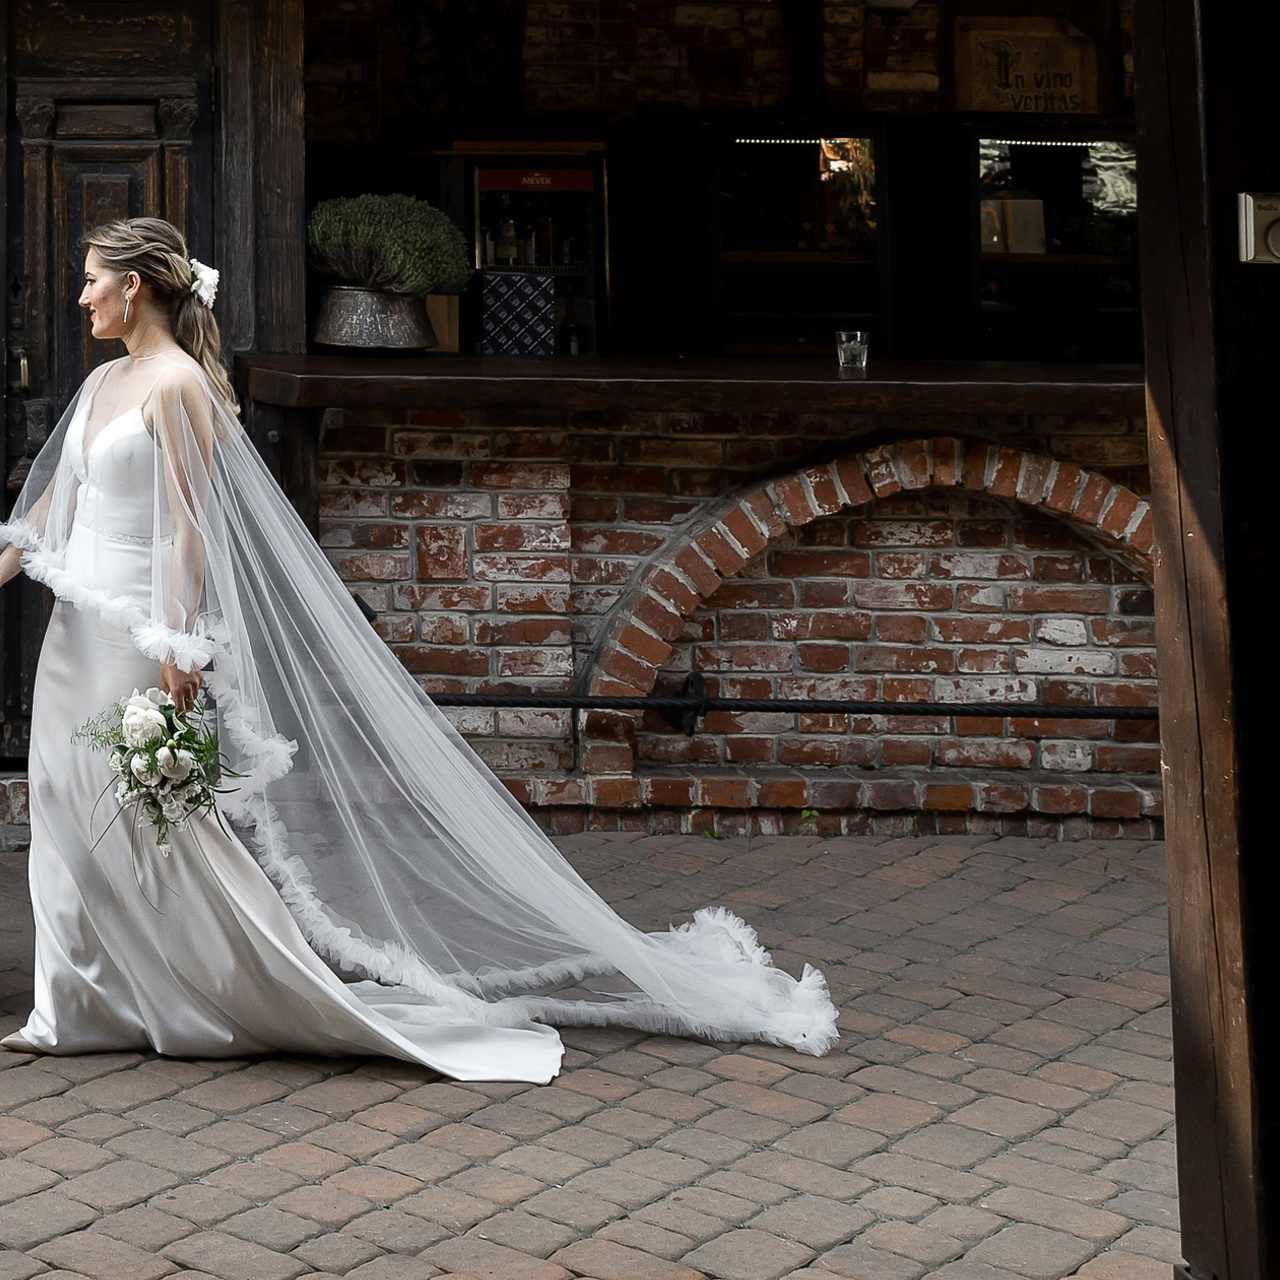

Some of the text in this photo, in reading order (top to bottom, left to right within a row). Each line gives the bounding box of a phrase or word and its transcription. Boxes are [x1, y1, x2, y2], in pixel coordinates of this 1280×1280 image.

[995, 51, 1073, 88] In vino
[1010, 91, 1080, 112] veritas
